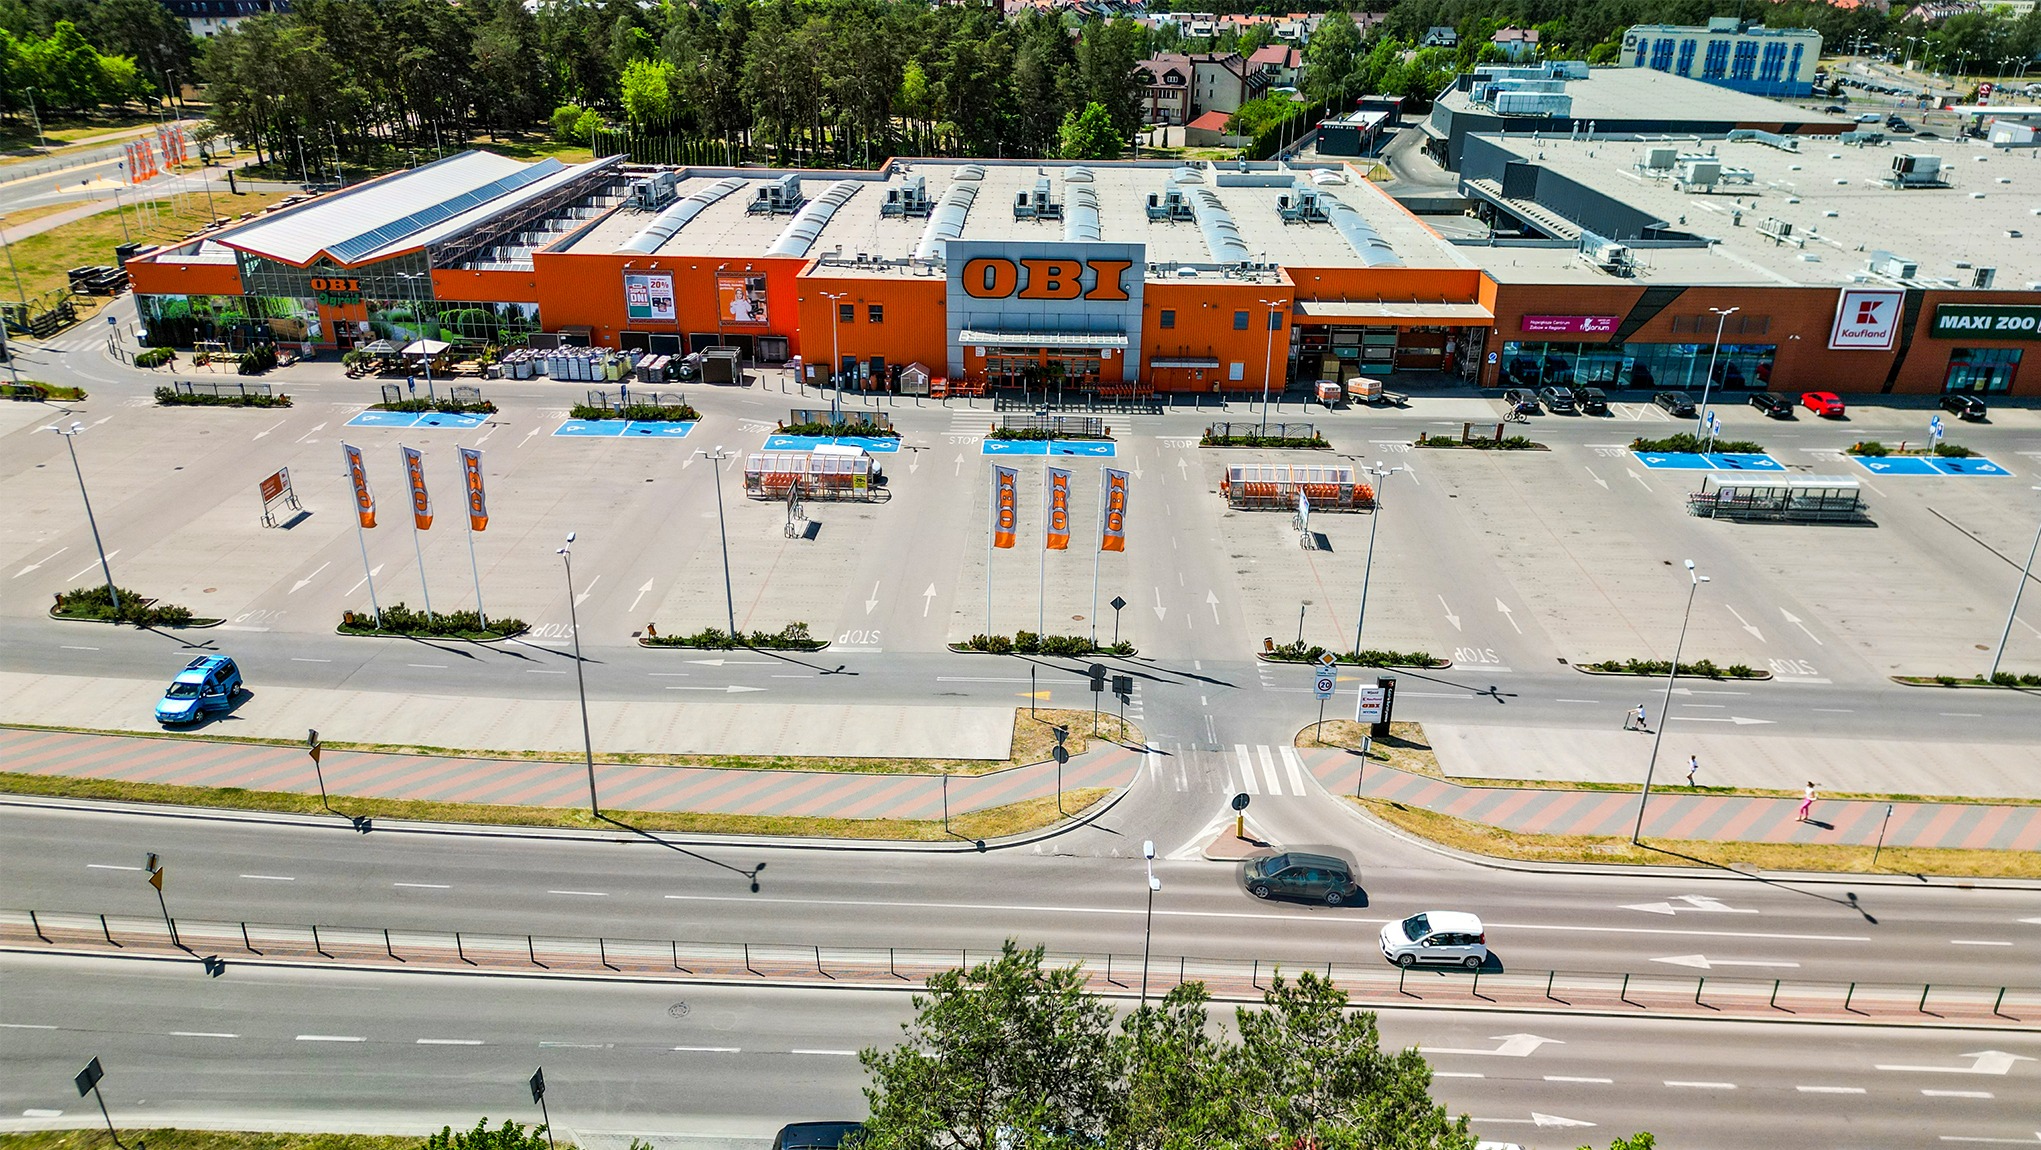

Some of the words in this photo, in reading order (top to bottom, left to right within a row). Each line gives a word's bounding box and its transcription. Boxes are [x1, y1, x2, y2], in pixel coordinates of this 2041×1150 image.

[310, 277, 361, 291] OBI
[962, 257, 1132, 301] OBI
[317, 292, 360, 307] Ogród
[630, 294, 648, 303] DNI
[1939, 315, 1992, 329] MAXI
[1996, 316, 2035, 330] ZOO
[1841, 328, 1887, 338] Kaufland
[949, 436, 979, 444] STOP
[1163, 440, 1193, 448] STOP
[1379, 444, 1410, 453] STOP
[1594, 448, 1627, 457] STOP
[348, 451, 372, 508] OBI
[408, 453, 428, 511] OBI
[465, 454, 482, 512] OBI
[999, 471, 1014, 528] OBI
[1052, 473, 1067, 530] OBI
[1108, 474, 1125, 531] OBI
[532, 623, 580, 638] STOP
[839, 630, 881, 644] STOP
[1455, 647, 1500, 664] STOP
[1769, 658, 1818, 675] STOP
[1320, 681, 1331, 689] 20
